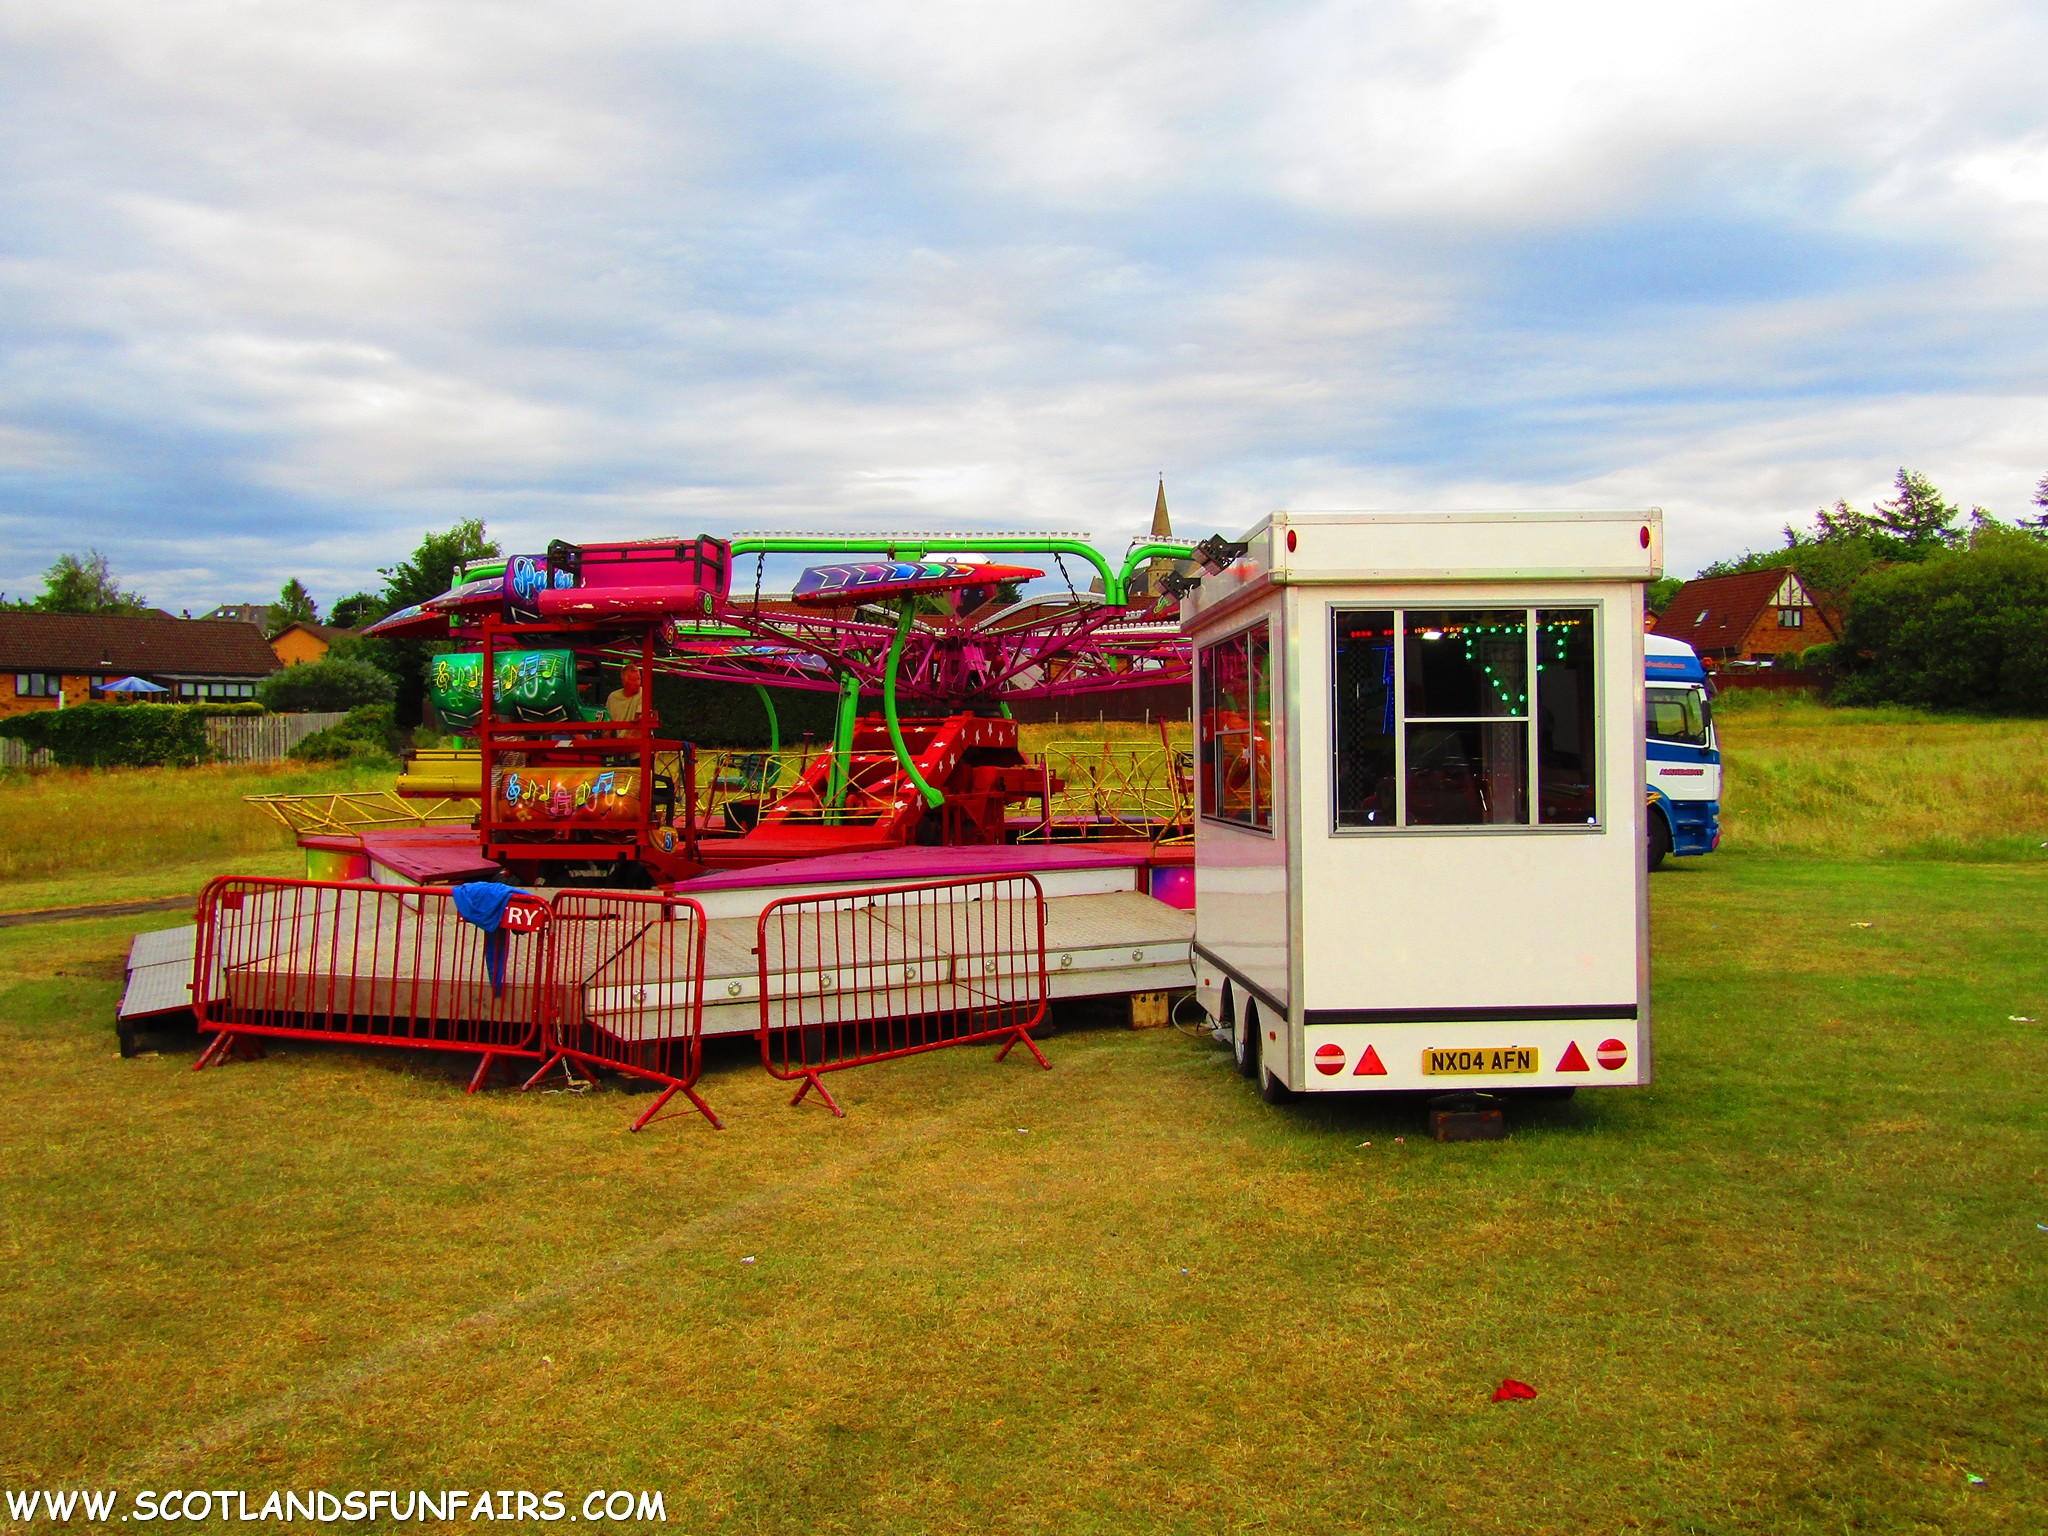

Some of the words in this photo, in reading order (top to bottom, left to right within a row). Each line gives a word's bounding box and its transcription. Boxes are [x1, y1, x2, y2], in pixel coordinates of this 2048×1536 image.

[513, 556, 574, 600] Paty
[704, 593, 713, 614] 8
[750, 781, 759, 791] 2
[1431, 1052, 1484, 1071] NX04
[1491, 1051, 1530, 1070] AFN
